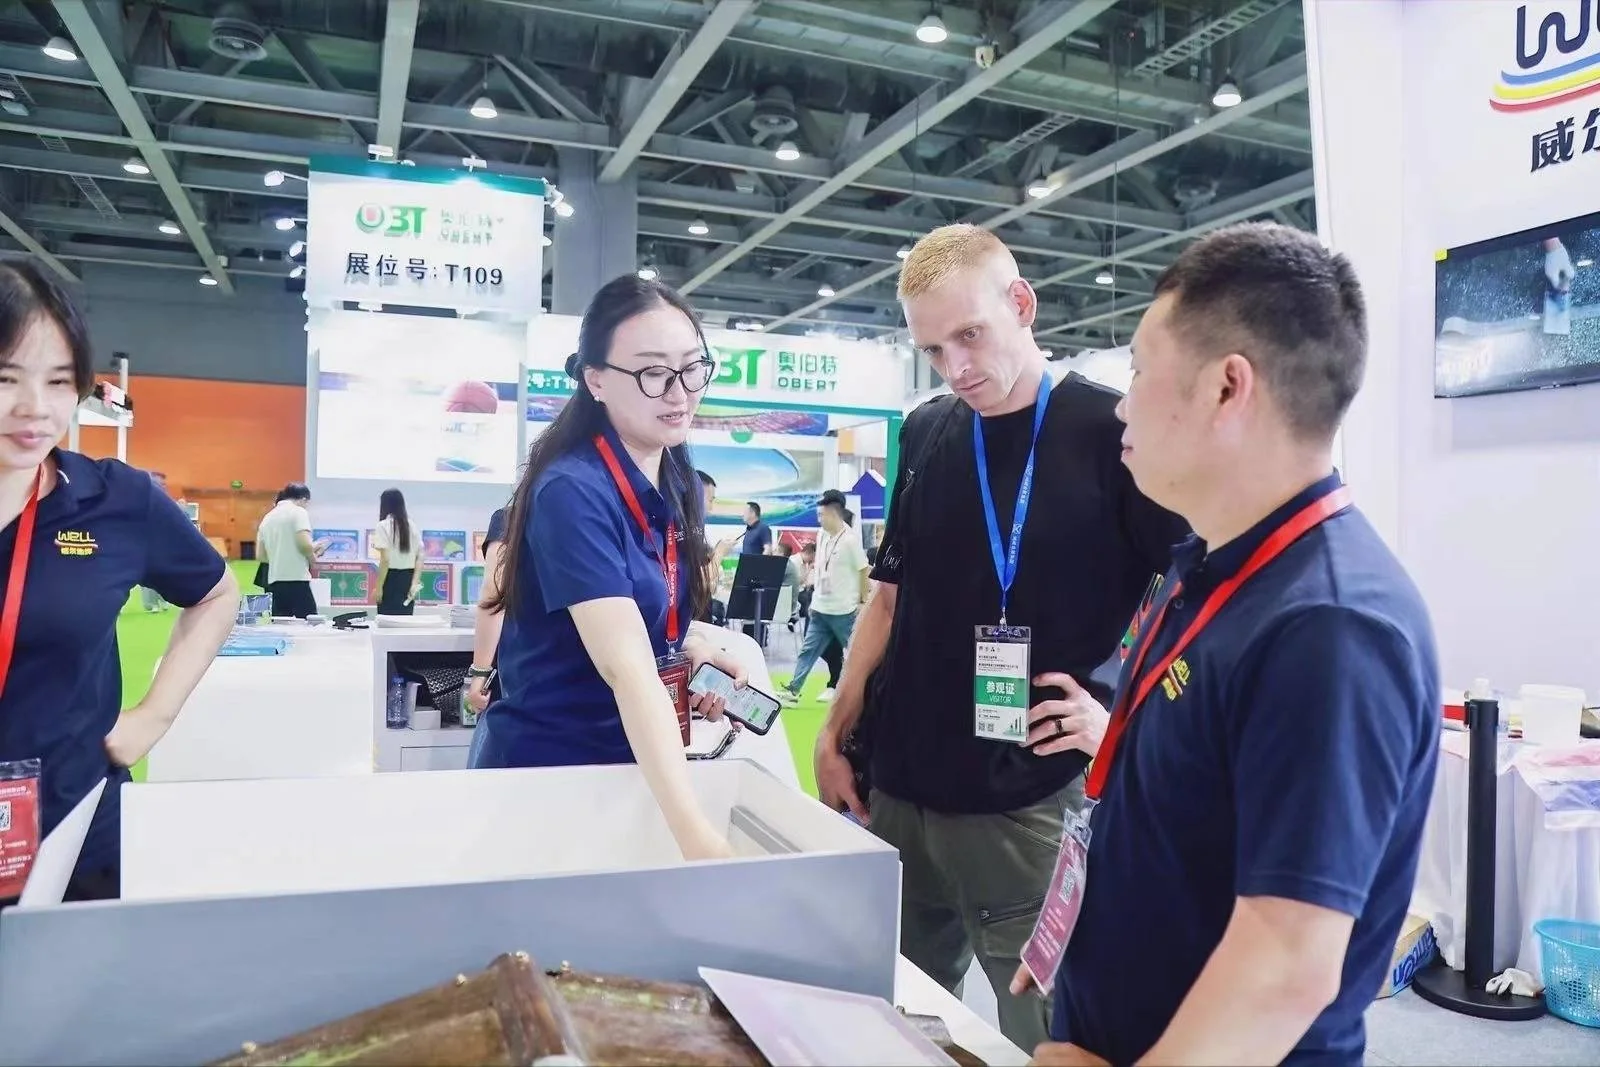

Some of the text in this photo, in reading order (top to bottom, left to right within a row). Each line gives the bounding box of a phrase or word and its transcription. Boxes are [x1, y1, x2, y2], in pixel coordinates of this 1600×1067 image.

[1516, 0, 1600, 69] W
[778, 351, 838, 374] 奥伯特
[777, 376, 838, 391] OBERT
[986, 681, 1016, 695] 参观证
[989, 695, 1012, 704] VISITOR
